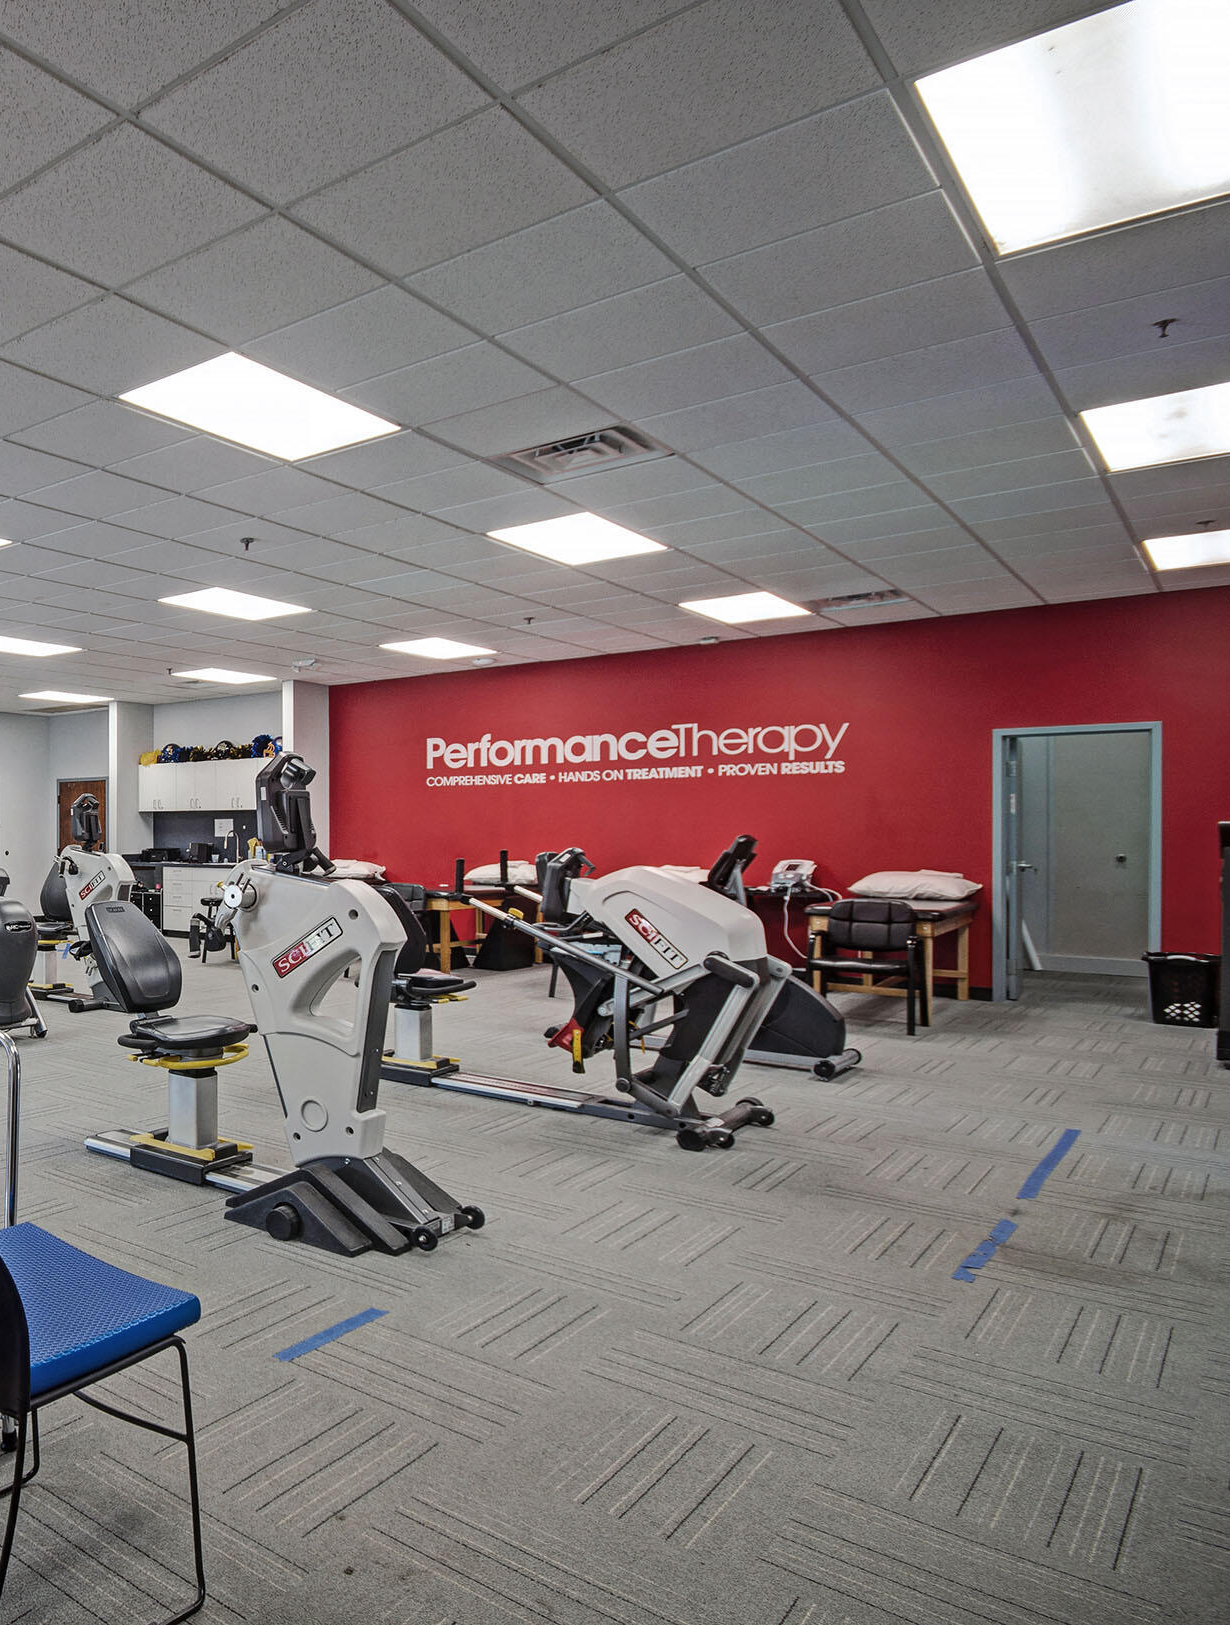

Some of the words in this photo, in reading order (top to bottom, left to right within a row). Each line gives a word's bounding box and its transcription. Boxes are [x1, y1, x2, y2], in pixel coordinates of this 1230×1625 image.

[426, 722, 850, 770] PerformanceTherapy
[425, 773, 513, 787] COMPREHENSIVE
[514, 772, 547, 785] CARE
[558, 770, 601, 783] HANDS
[601, 769, 624, 782] ON
[624, 765, 704, 781] TREATMENT
[717, 762, 778, 777] PROVEN
[780, 760, 846, 775] RESULTS
